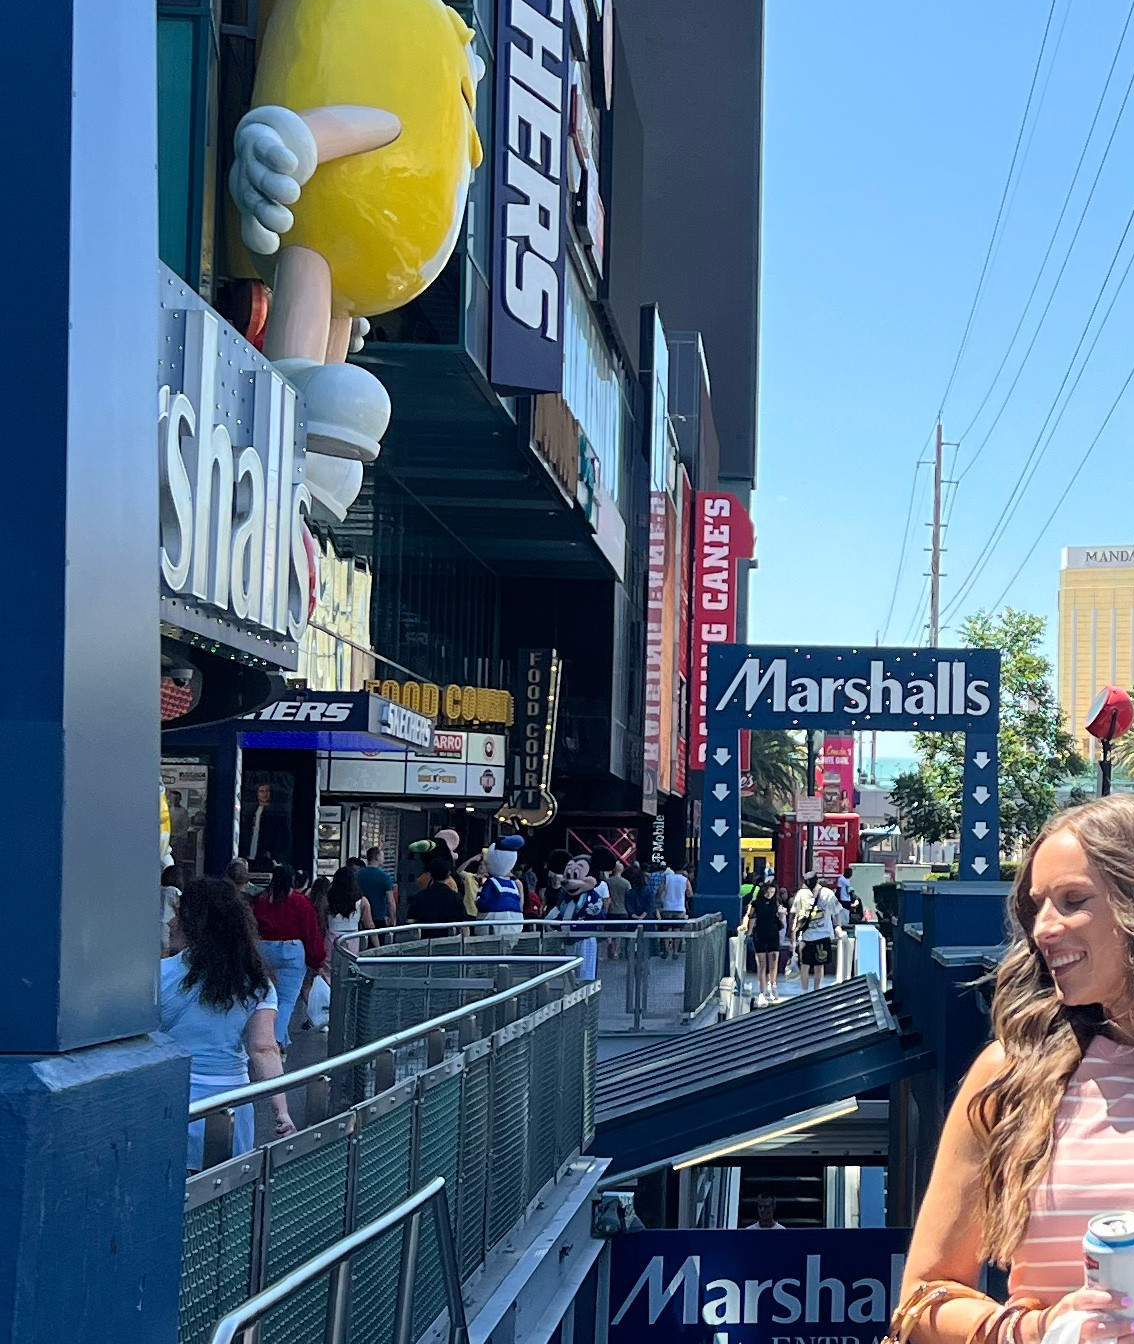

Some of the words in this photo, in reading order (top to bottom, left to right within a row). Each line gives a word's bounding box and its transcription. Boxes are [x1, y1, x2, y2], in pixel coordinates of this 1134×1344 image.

[160, 308, 312, 642] shalls
[702, 498, 731, 611] CANE'S
[526, 652, 542, 716] FOOD
[715, 658, 991, 716] Marshalls
[433, 735, 462, 749] ARRO
[525, 723, 540, 803] COURT
[803, 825, 840, 841] IX4
[611, 1254, 905, 1326] Marshal
